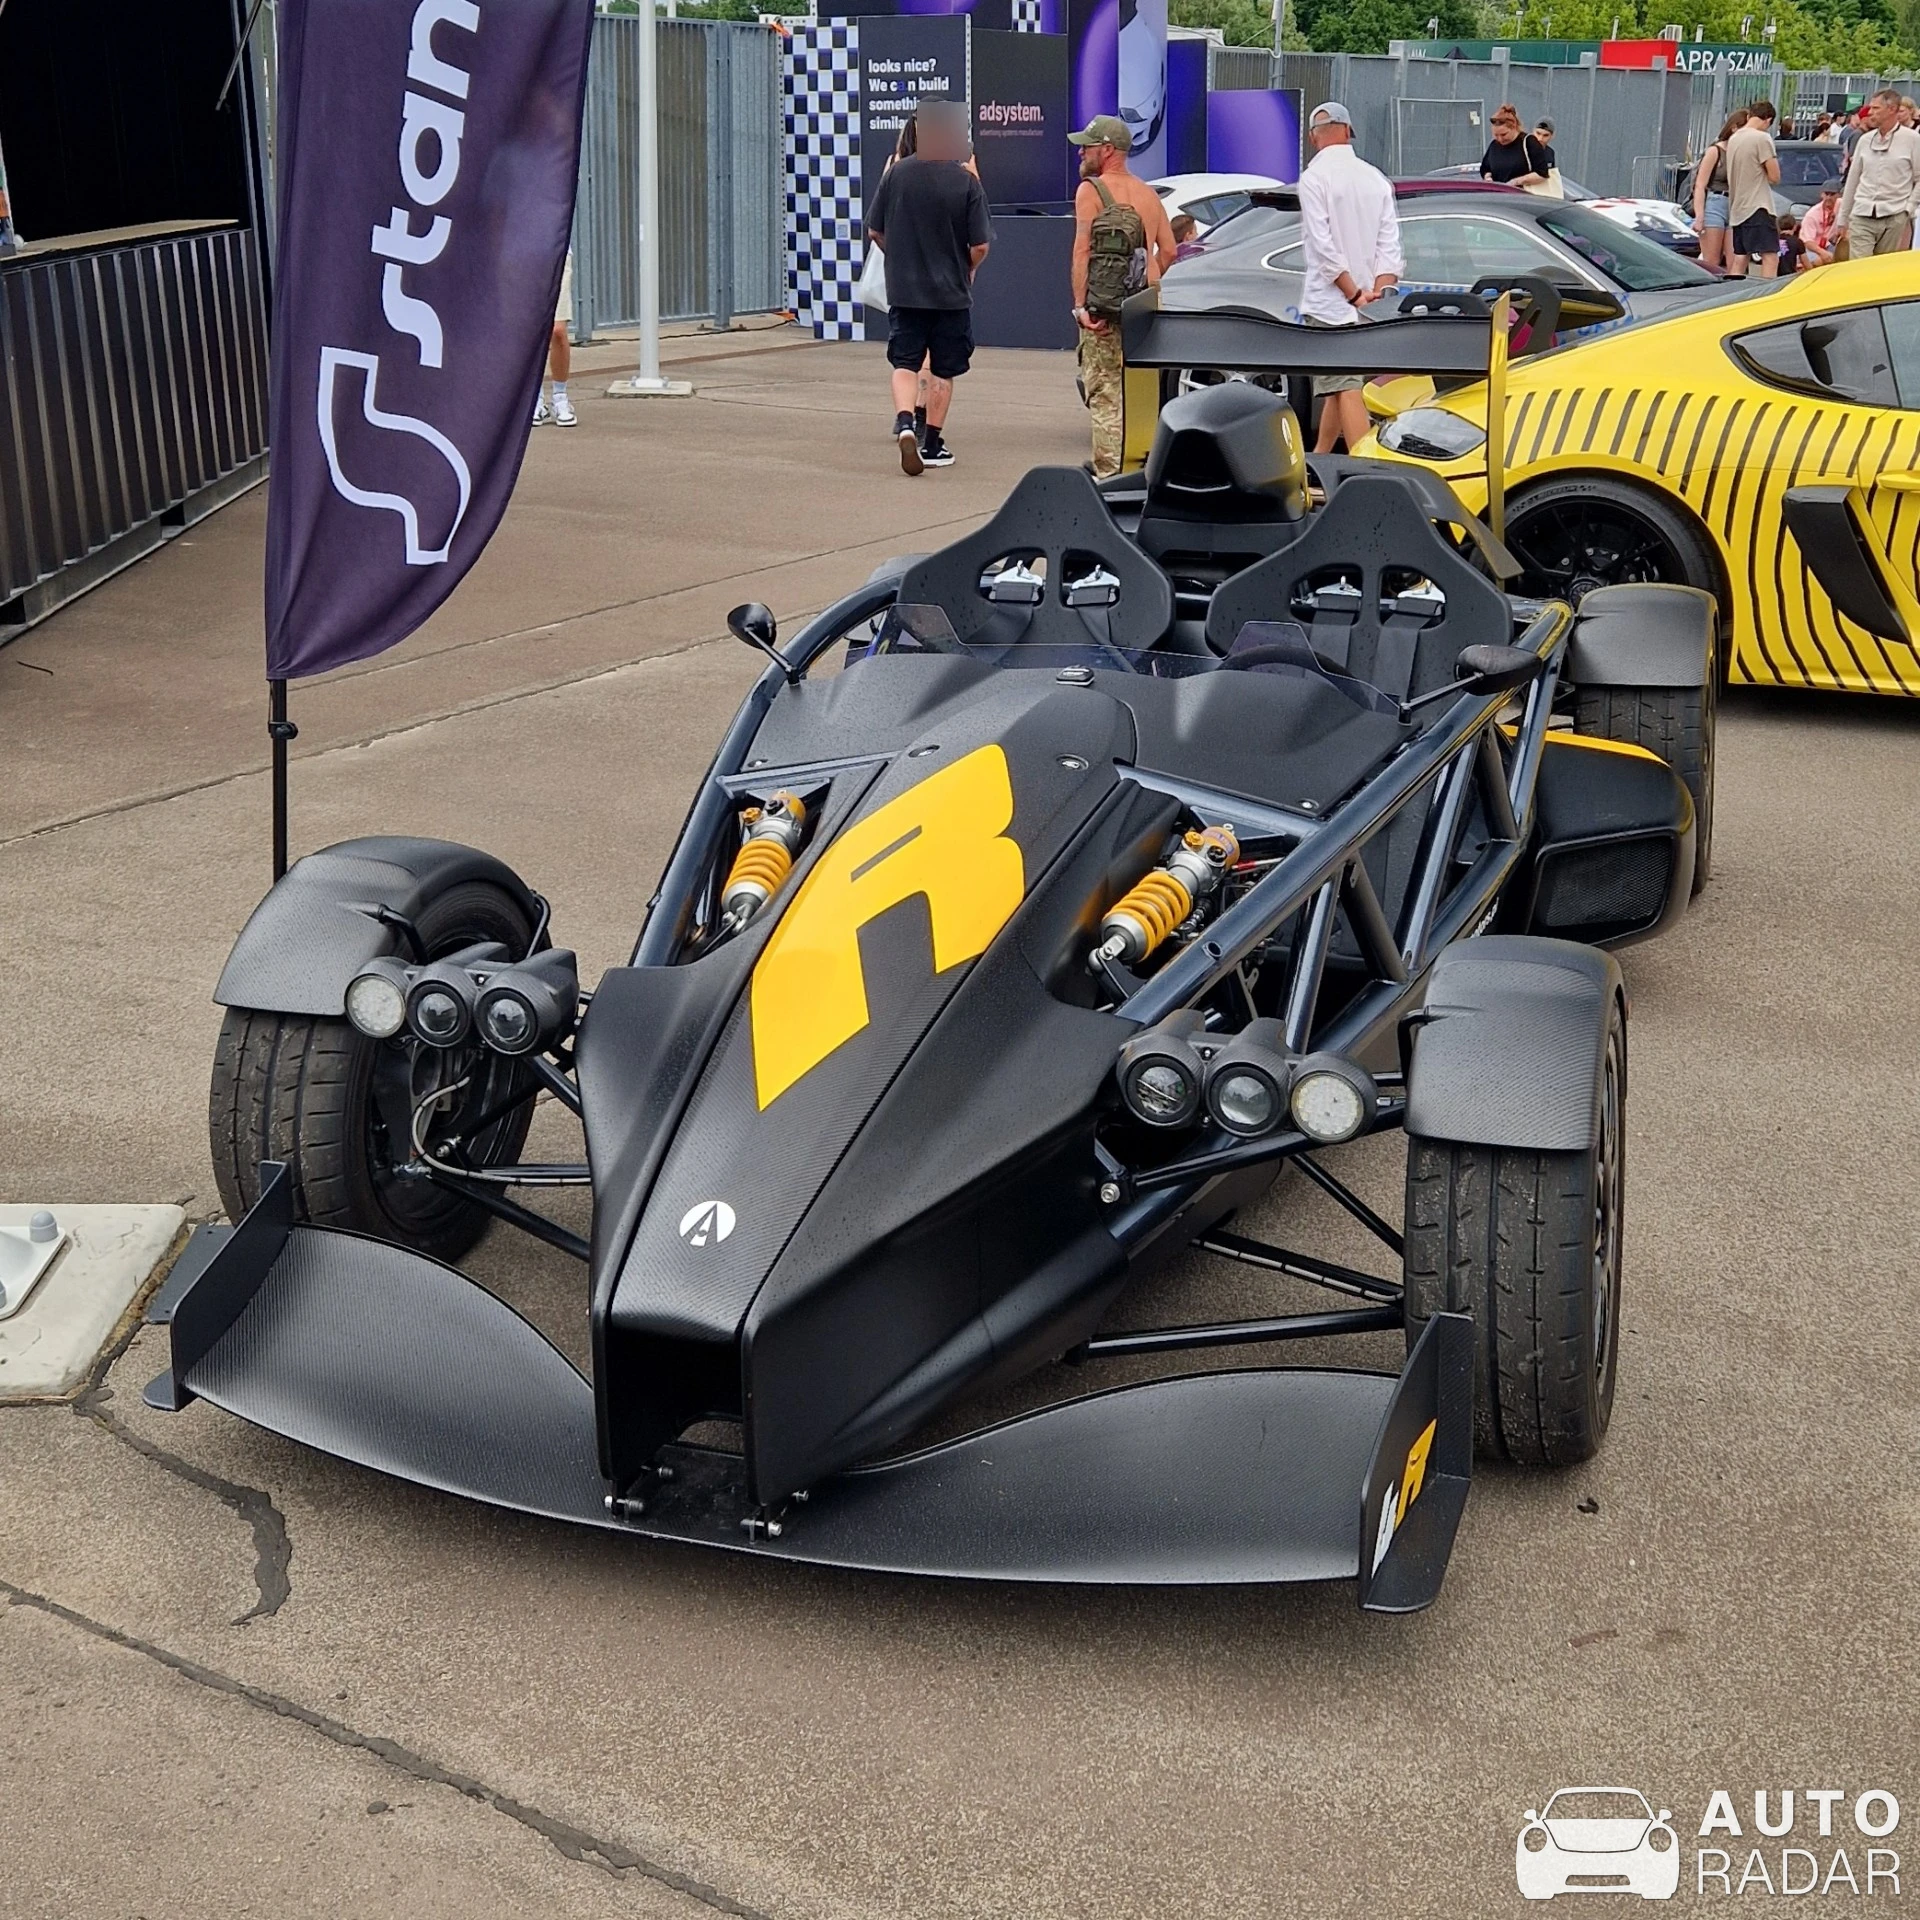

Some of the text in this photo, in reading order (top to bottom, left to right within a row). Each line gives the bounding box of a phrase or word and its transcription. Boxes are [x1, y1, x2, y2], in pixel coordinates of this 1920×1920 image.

[868, 58, 937, 73] looks nice?
[1675, 49, 1772, 71] APRASZAMY!
[868, 76, 949, 92] We can build
[868, 96, 920, 111] somethi
[979, 99, 1044, 126] adsystem.
